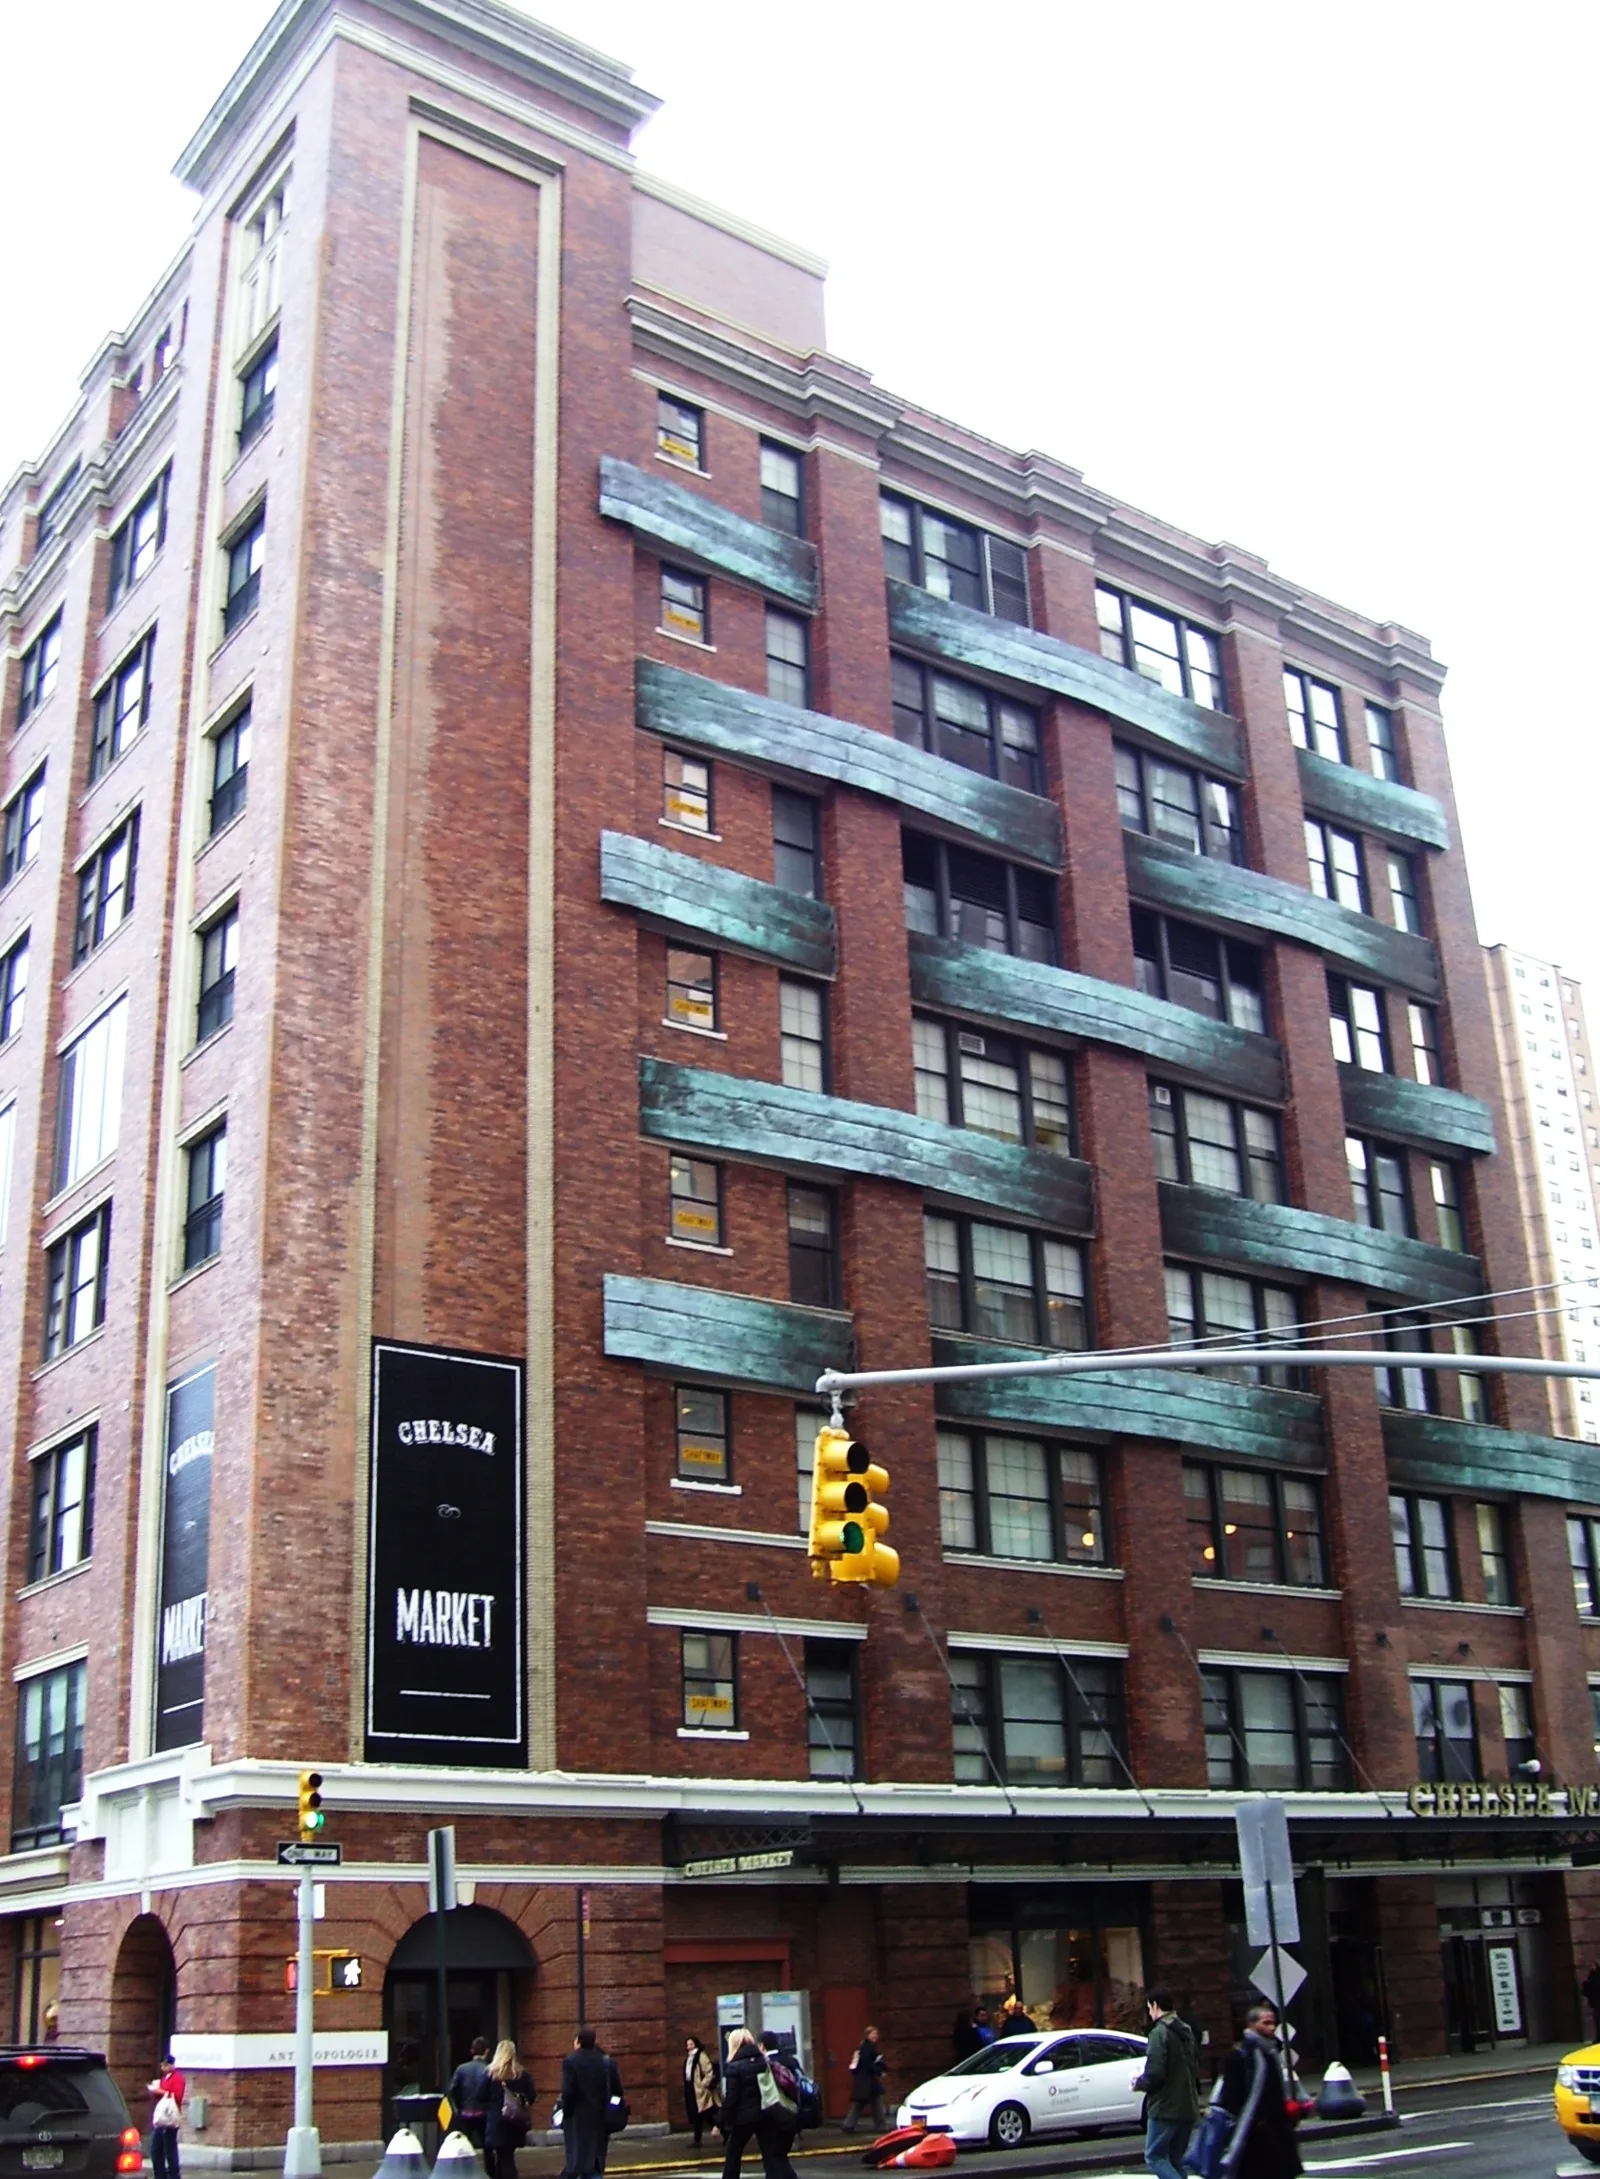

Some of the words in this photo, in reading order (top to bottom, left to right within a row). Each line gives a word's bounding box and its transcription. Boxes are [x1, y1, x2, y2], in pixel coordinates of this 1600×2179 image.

[398, 1420, 496, 1455] CHELSEA
[396, 1588, 495, 1648] MARKET
[1409, 1782, 1556, 1818] CHELSEA
[268, 2050, 379, 2061] ANTOPOLOGIE
